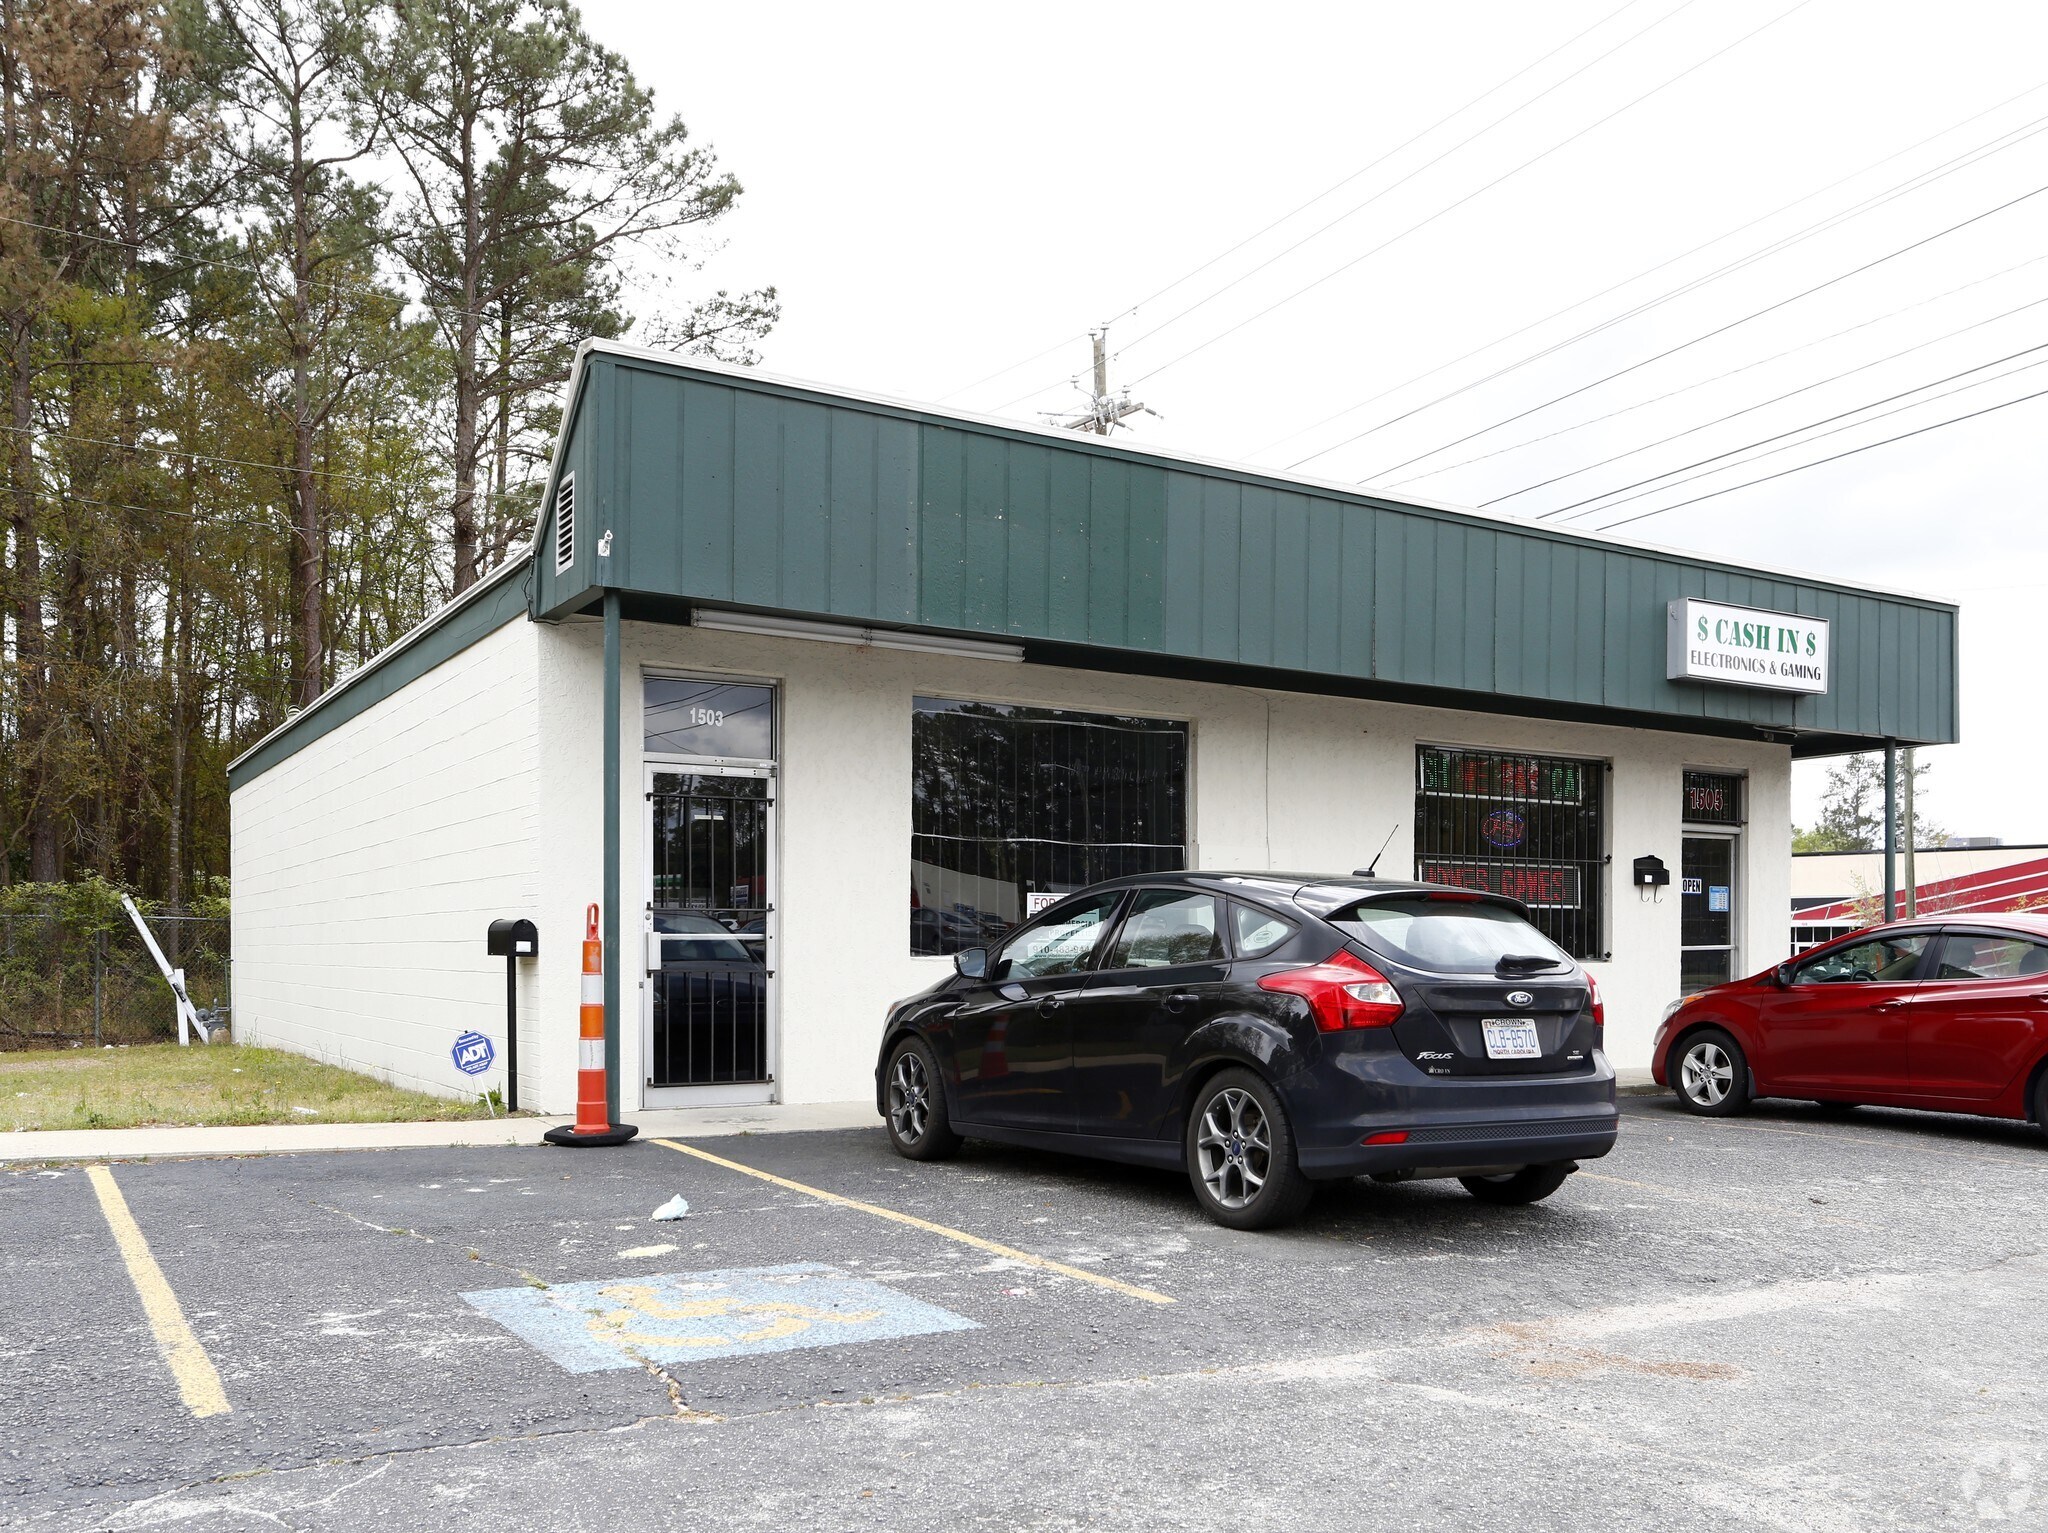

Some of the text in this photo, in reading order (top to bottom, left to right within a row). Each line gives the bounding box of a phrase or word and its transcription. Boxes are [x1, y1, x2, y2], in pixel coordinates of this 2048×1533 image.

[1715, 618, 1770, 650] CASH
[1777, 627, 1799, 654] IN
[1691, 650, 1821, 681] ELECTRONICS & GAMING
[690, 707, 723, 727] 1503
[1690, 787, 1724, 811] 1505
[1682, 879, 1700, 892] OPEN
[1495, 1018, 1523, 1026] CROWN
[1487, 1029, 1536, 1048] CLB-8570
[460, 1042, 487, 1065] ADT
